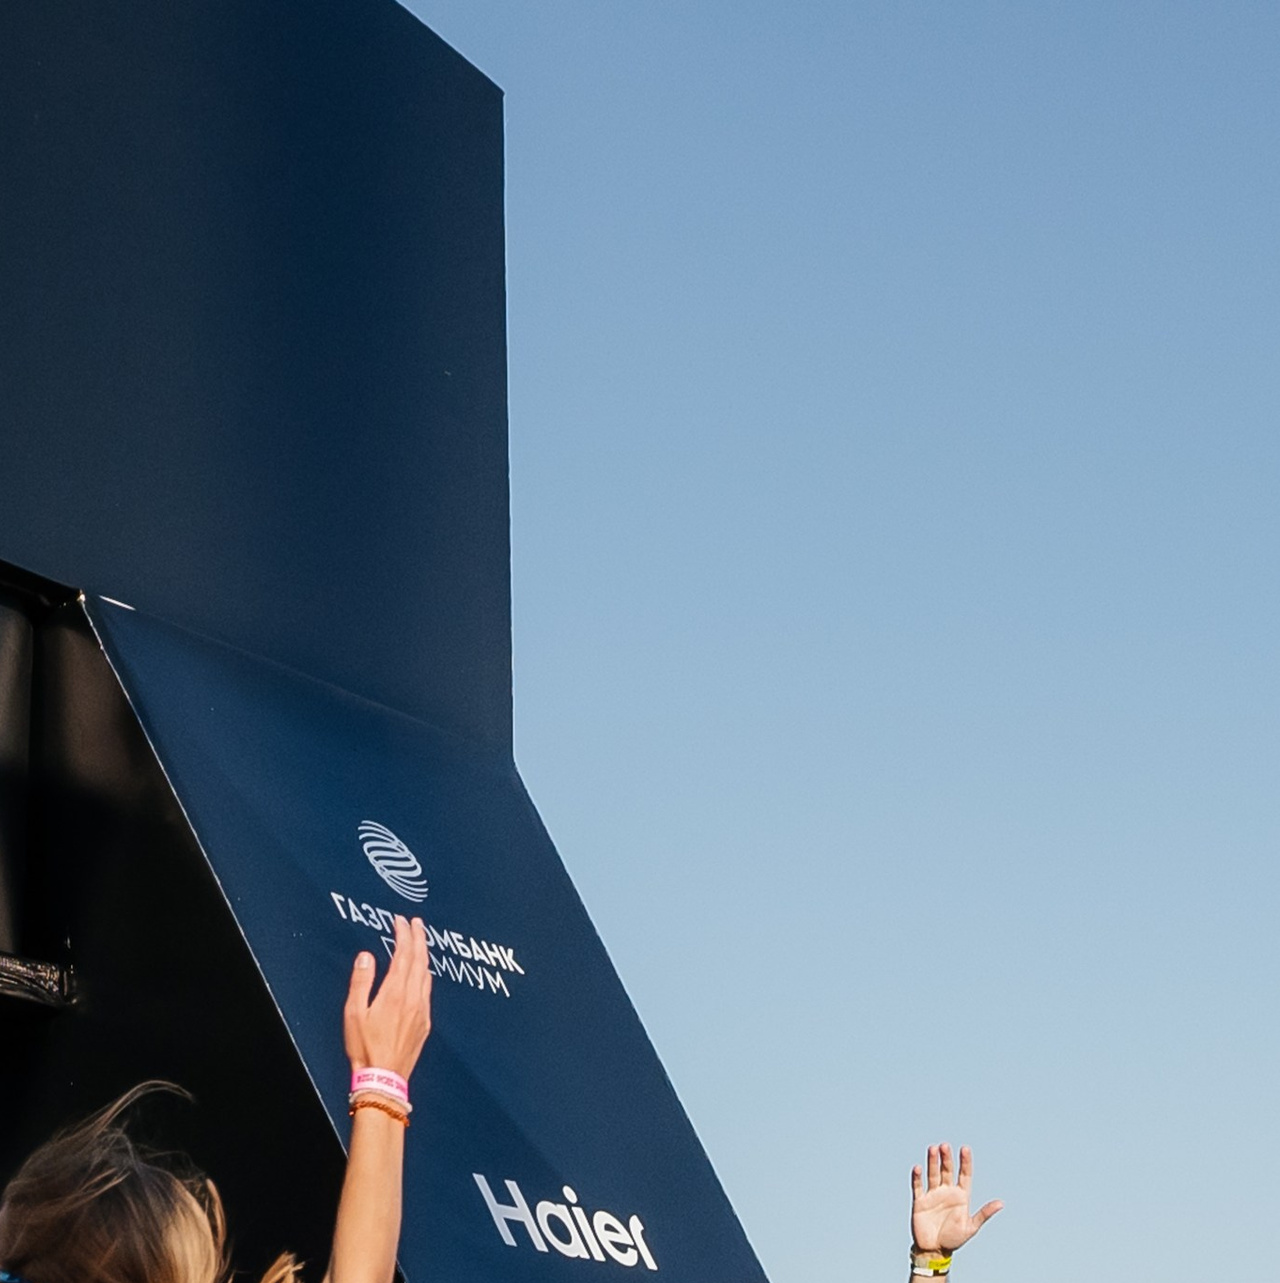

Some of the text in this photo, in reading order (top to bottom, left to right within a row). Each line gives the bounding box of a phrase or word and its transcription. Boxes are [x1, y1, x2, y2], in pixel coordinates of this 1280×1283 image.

[330, 891, 526, 975] ГАЗПОМБАНК
[380, 935, 511, 998] ПМИУМ
[472, 1172, 659, 1271] Haier
